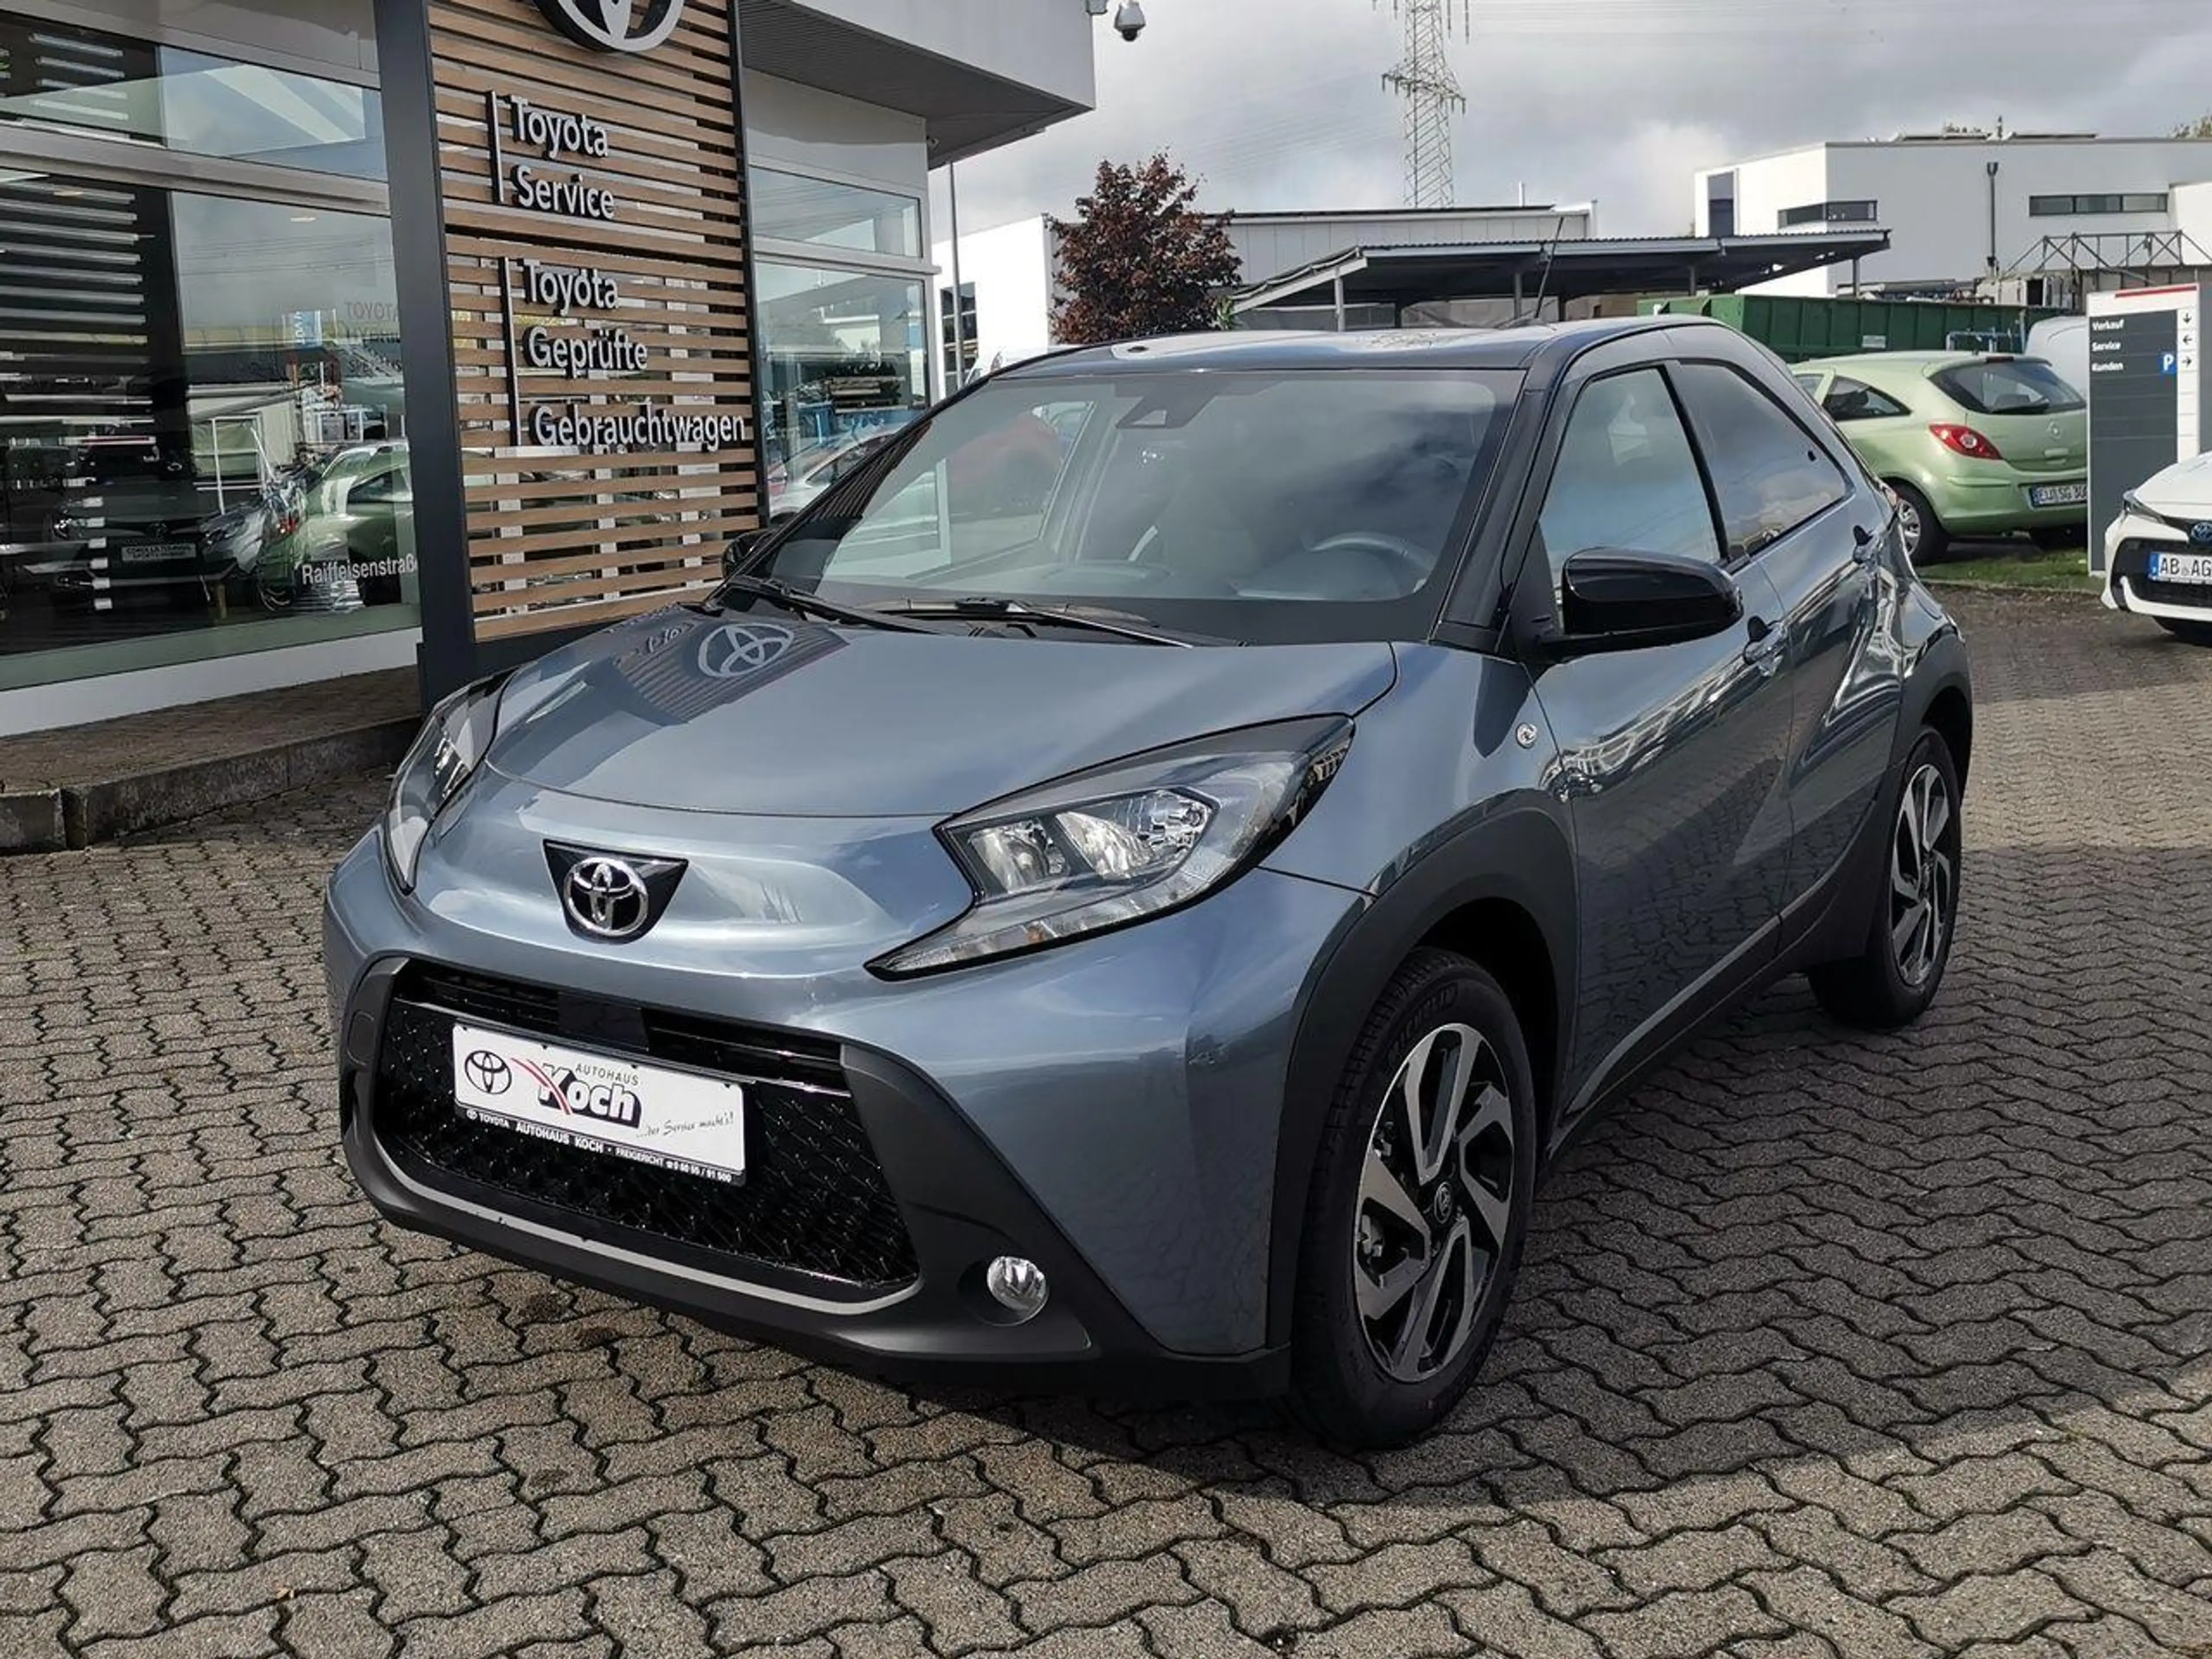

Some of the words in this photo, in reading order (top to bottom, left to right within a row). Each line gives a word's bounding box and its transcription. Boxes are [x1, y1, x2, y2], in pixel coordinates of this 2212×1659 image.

[510, 94, 608, 159] Toyota
[517, 165, 615, 219] Service
[523, 258, 619, 316] Toyota
[2092, 319, 2125, 331] Verkauf
[2092, 341, 2122, 352] Service
[528, 326, 648, 379] Geprüfte
[2092, 361, 2124, 372] Kunden
[2163, 353, 2174, 372] P
[535, 396, 745, 452] Gebrauchtwagen
[2160, 558, 2180, 575] AB
[2191, 559, 2212, 577] AG
[538, 1063, 641, 1127] Koch
[575, 1063, 639, 1086] AUTOHAUS
[479, 1112, 510, 1129] TOYOTA
[516, 1122, 570, 1145] AUTOHAUS
[574, 1135, 604, 1153] KOCH
